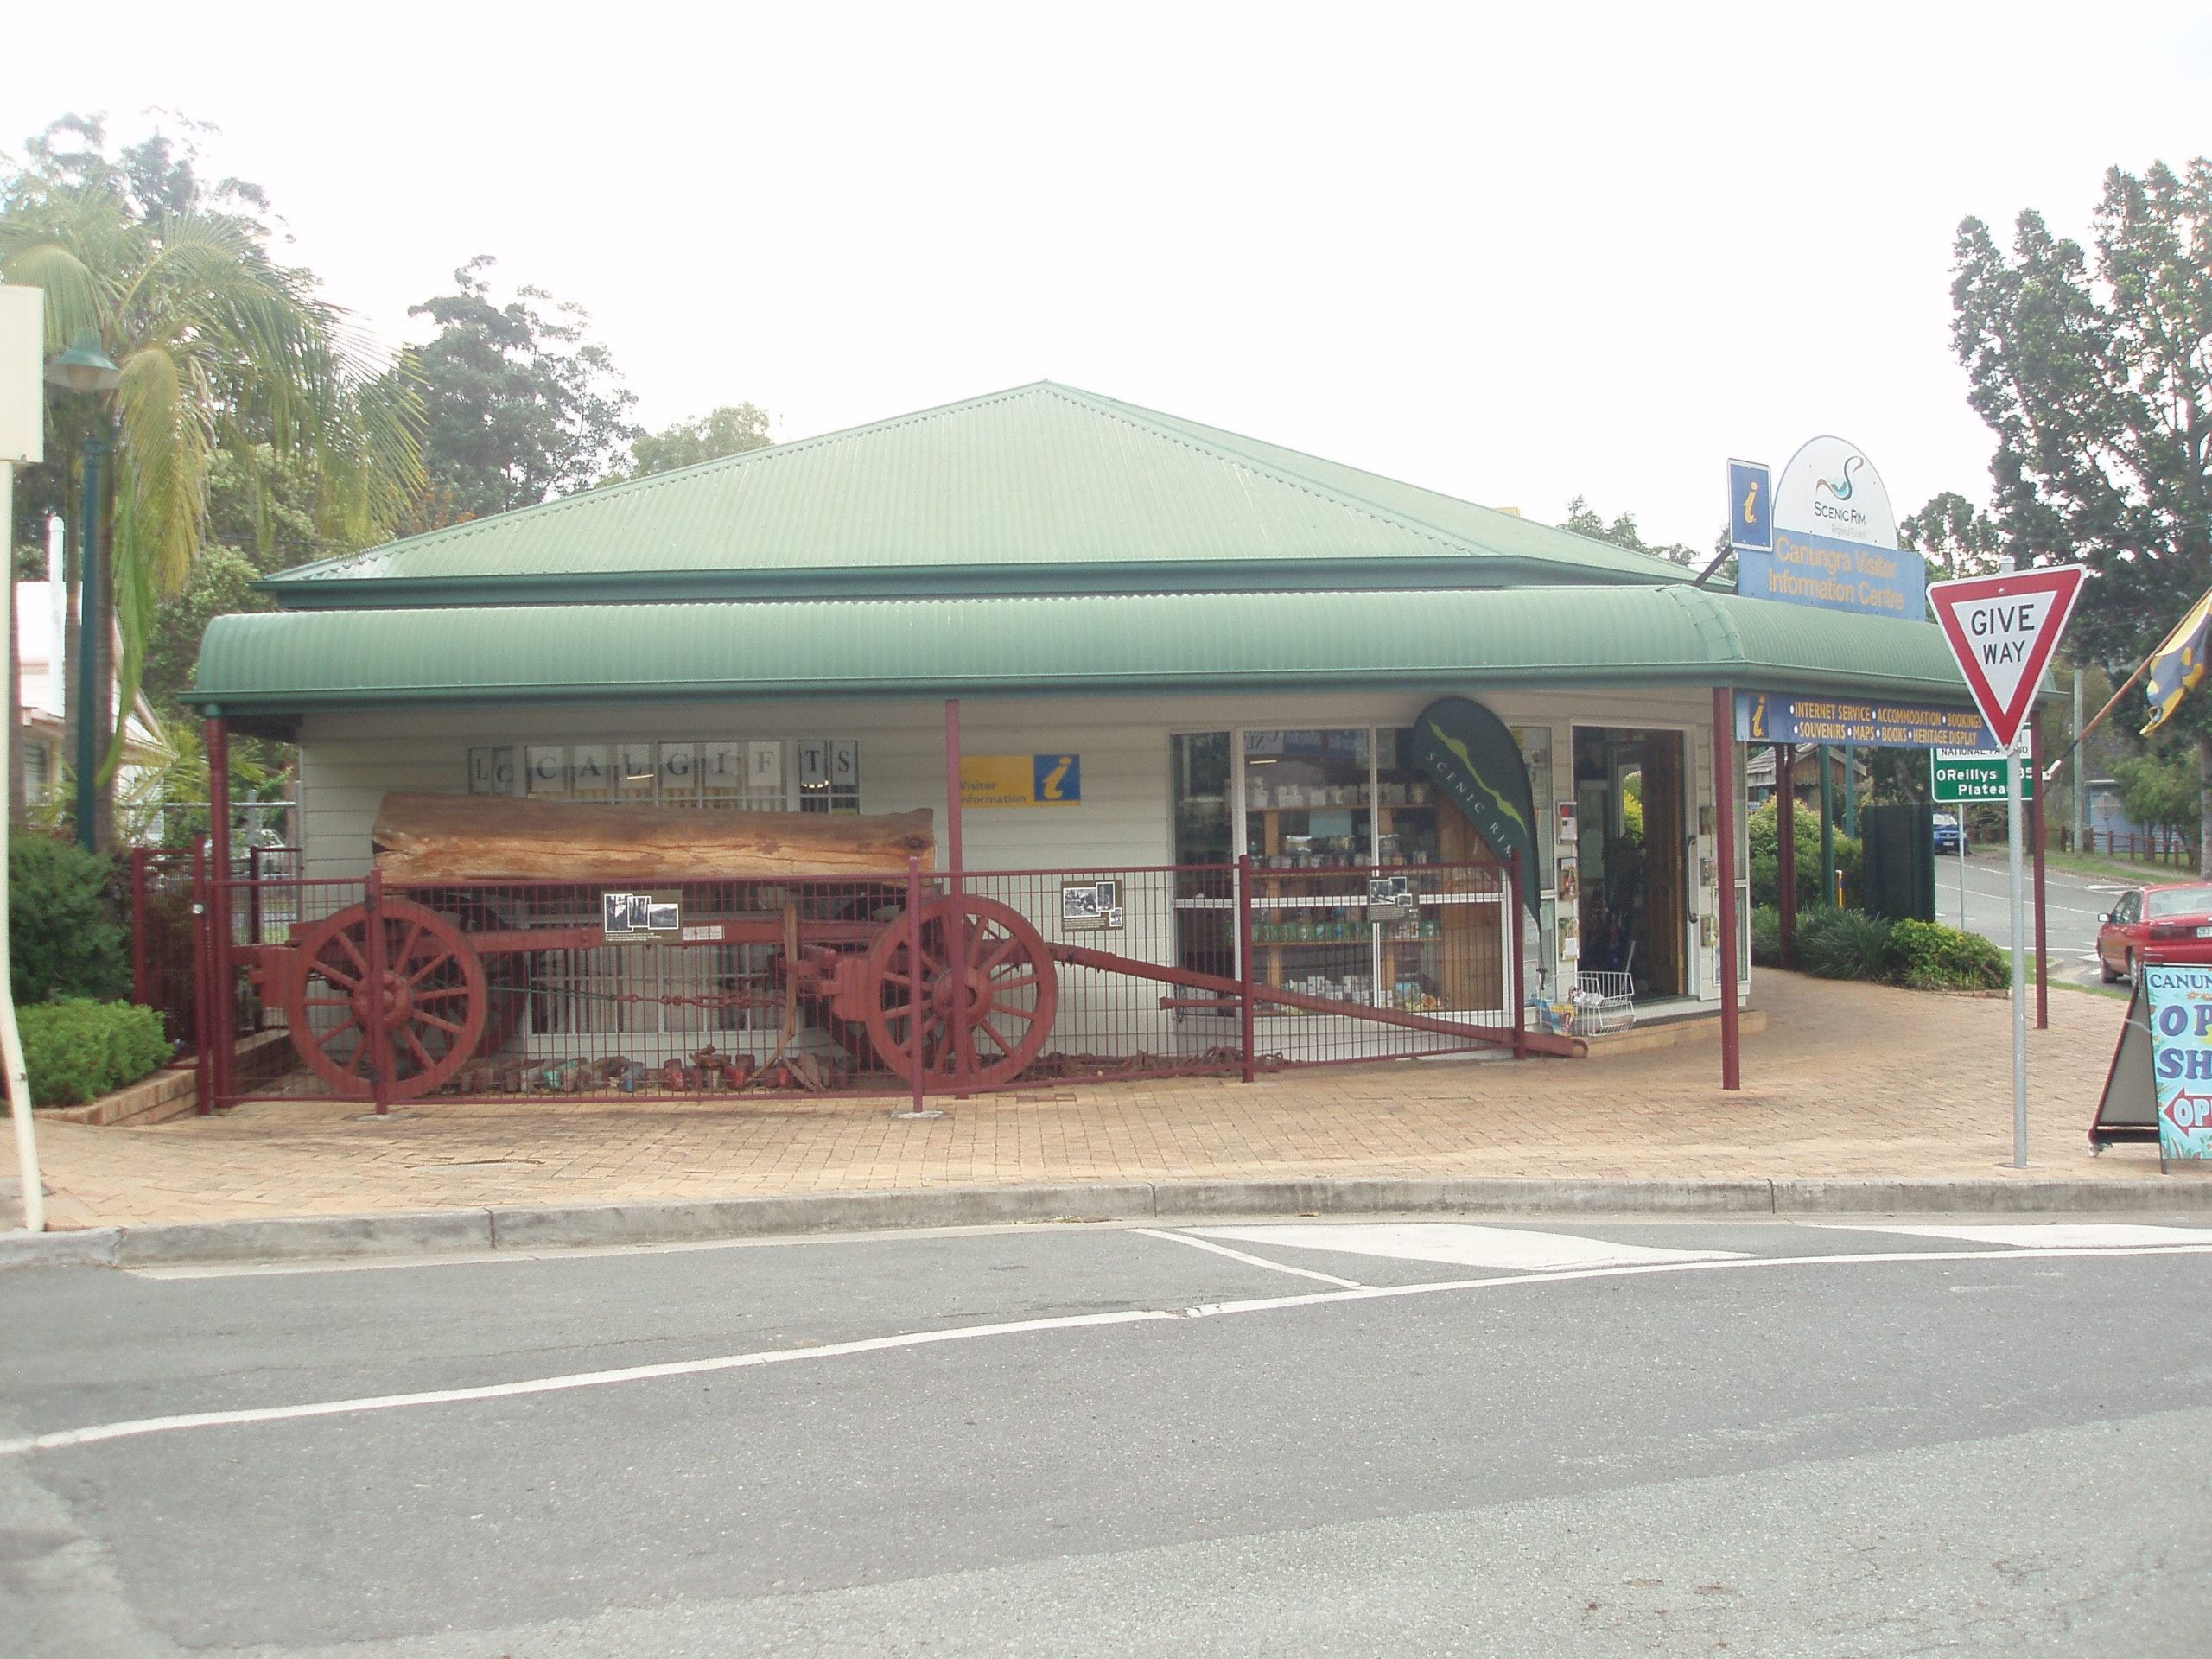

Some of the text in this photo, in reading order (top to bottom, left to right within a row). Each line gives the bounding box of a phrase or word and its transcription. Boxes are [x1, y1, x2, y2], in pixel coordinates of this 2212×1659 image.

[1851, 509, 1866, 525] RIM
[1777, 534, 1897, 578] Canungra Visitor
[1768, 567, 1905, 610] Information Centre
[1971, 604, 2035, 636] GIVE
[1983, 640, 2025, 665] WAY
[1795, 702, 1982, 728] INTERNET SERVICE ACCOMMODATION BOOKINGS
[1799, 722, 1977, 746] SOUVENIRS MAPS BOOKS HERITAGE DISPLAY
[1427, 753, 1484, 814] SCENIC
[1958, 785, 2007, 796] Platea
[960, 794, 1027, 804] nformation
[2157, 1047, 2212, 1080] SH
